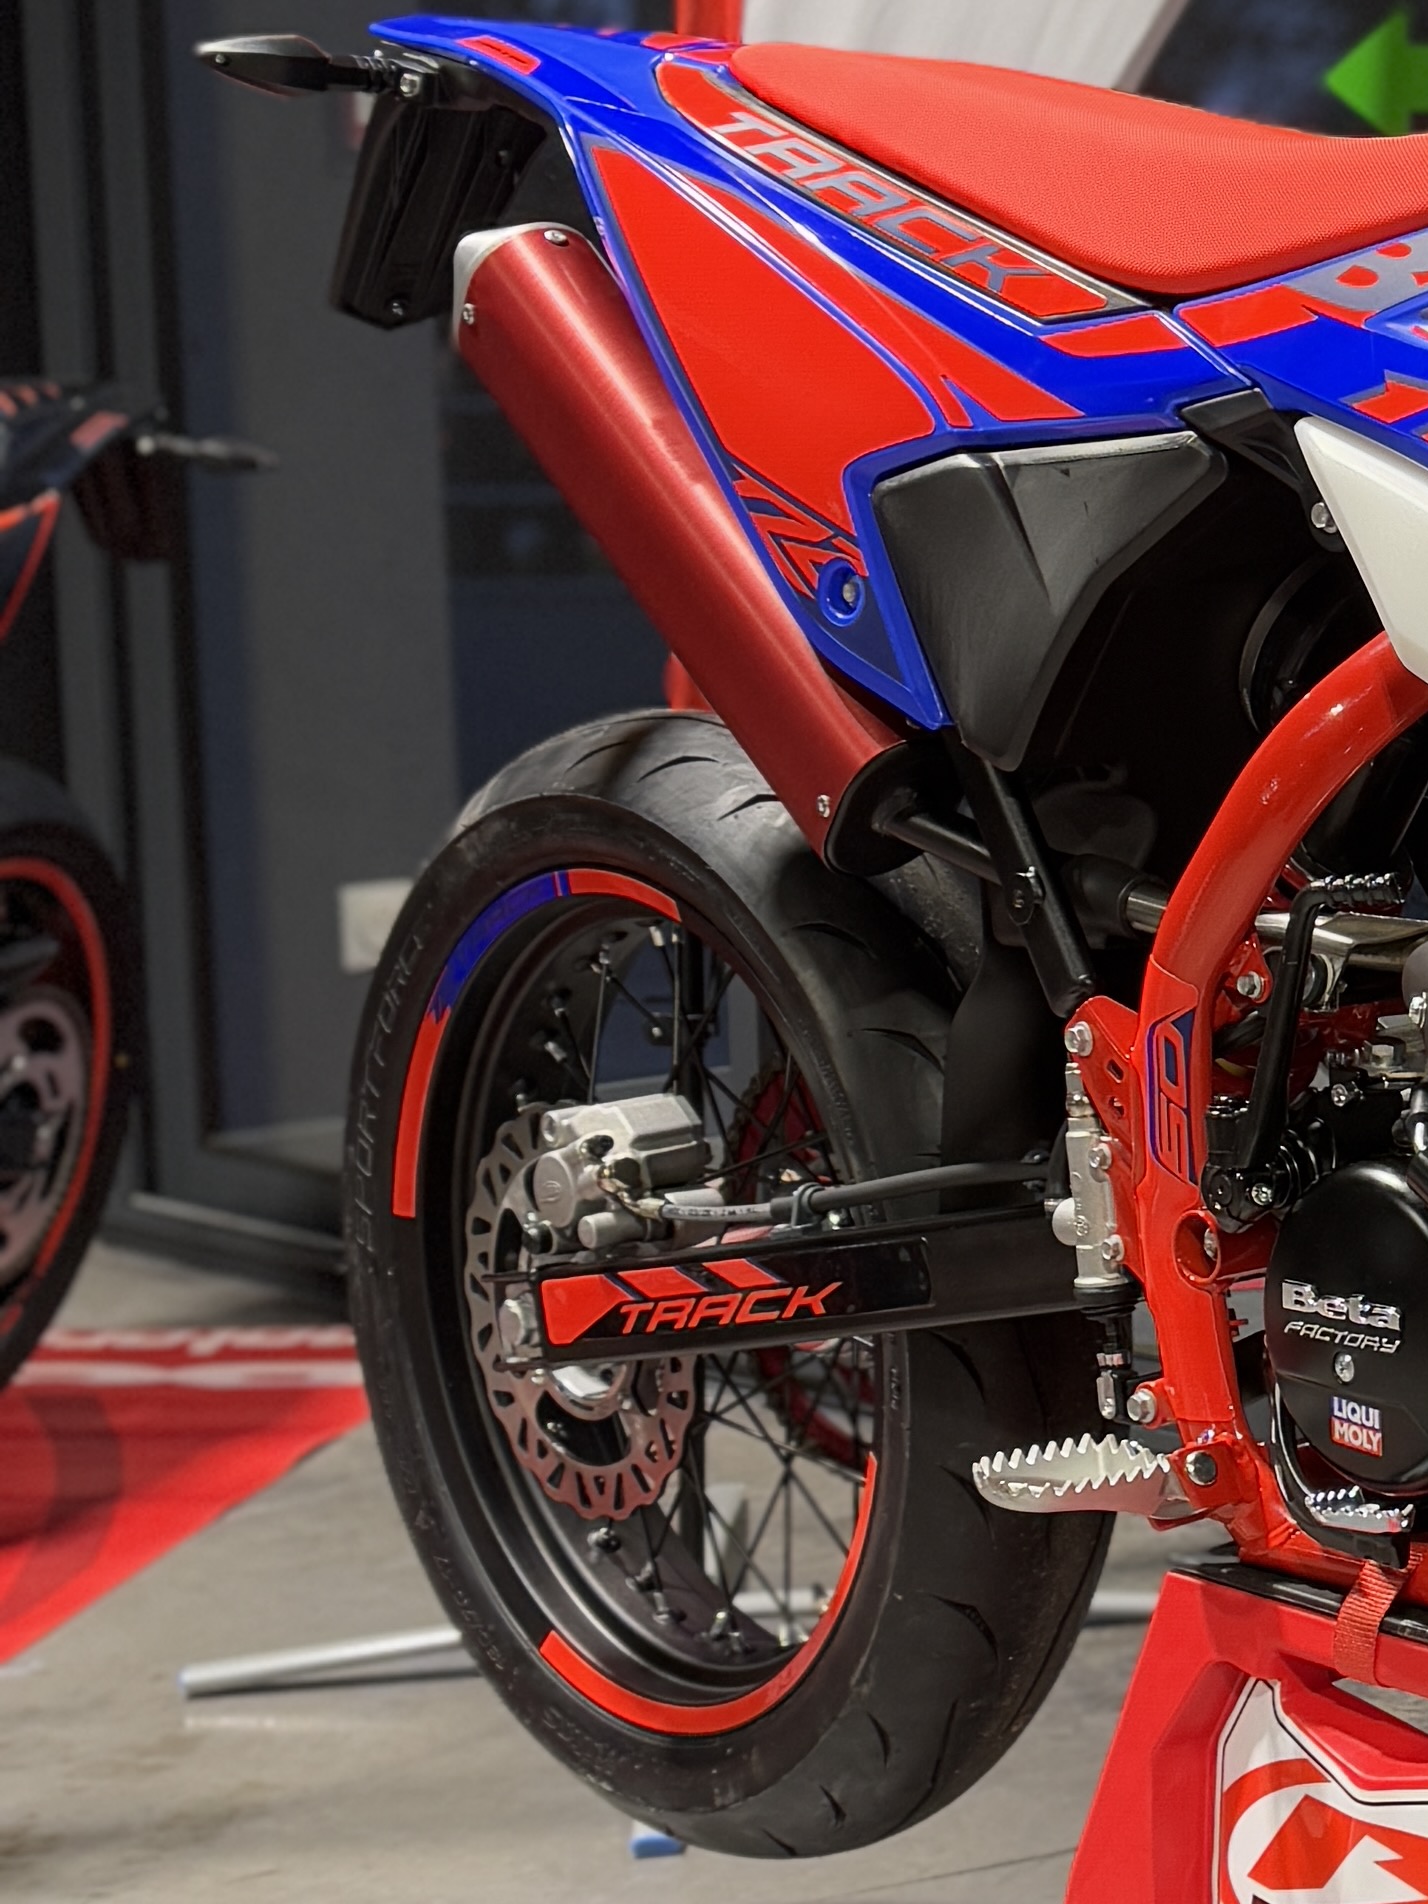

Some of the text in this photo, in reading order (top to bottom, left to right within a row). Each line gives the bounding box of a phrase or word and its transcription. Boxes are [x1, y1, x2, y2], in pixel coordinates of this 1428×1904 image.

[709, 110, 1052, 297] TRACK
[620, 1281, 844, 1335] TRACK
[1282, 1279, 1402, 1331] Beta
[1284, 1321, 1401, 1354] FACTORY
[1332, 1396, 1381, 1430] LIQUI
[1333, 1421, 1383, 1453] MOLY
